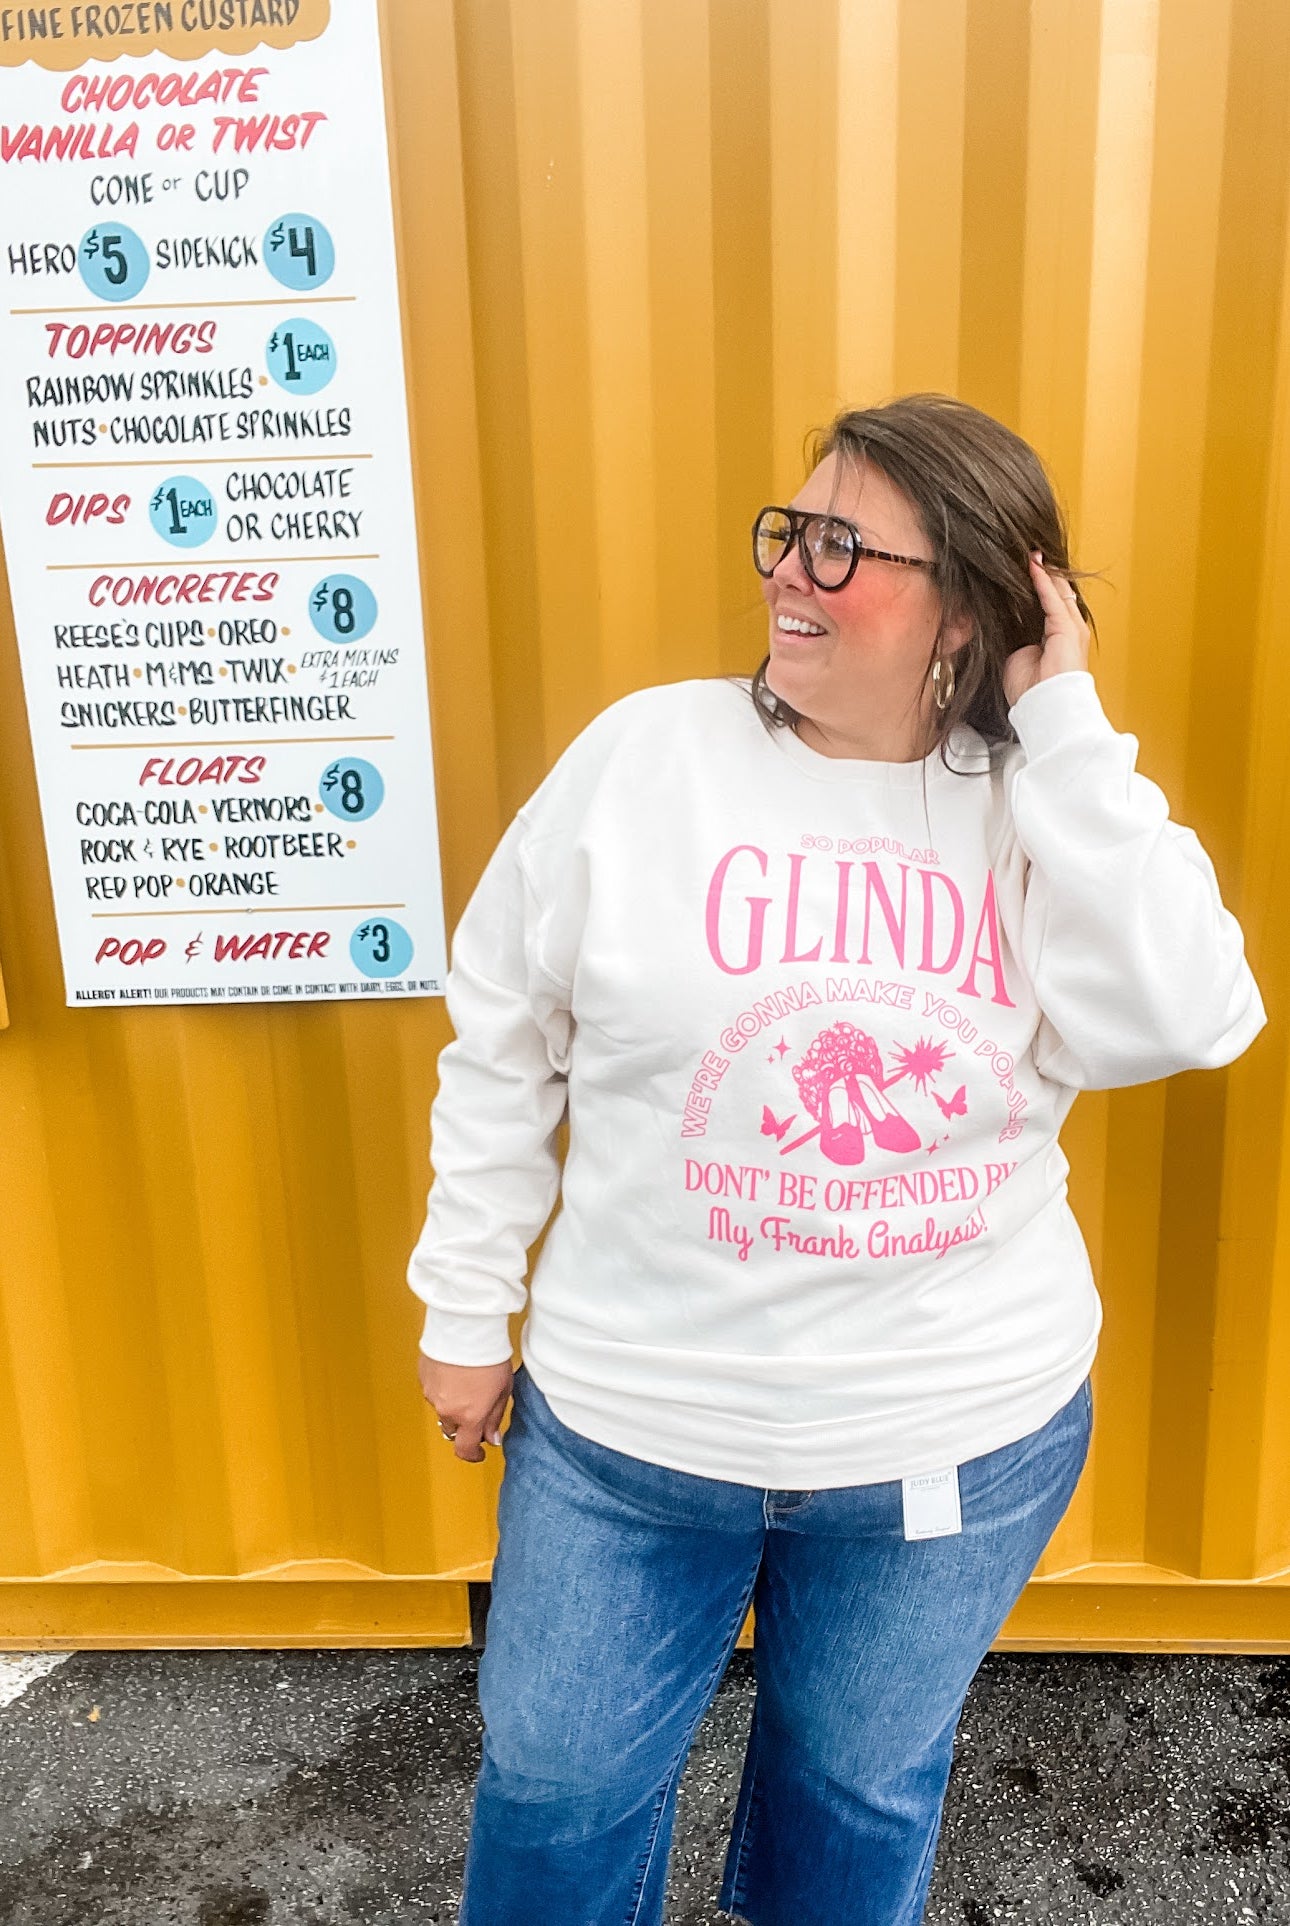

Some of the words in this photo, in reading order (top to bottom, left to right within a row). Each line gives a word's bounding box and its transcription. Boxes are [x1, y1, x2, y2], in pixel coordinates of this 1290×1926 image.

[1, 8, 65, 42] FINE
[71, 1, 173, 39] FROZEN
[180, 0, 299, 32] CUSTARD
[61, 67, 270, 114] CHOCOLATE
[0, 121, 140, 164] VANILLA
[156, 123, 196, 151] OR
[212, 111, 328, 155] TWIST
[90, 172, 155, 206] CONE
[162, 177, 182, 192] or
[194, 168, 250, 202] CUP
[7, 242, 77, 277] HERO
[83, 229, 129, 285] $5
[155, 235, 259, 269] SIDEKICK
[269, 222, 317, 277] $4
[44, 320, 218, 360] TOPPINGS
[269, 332, 301, 381] $1
[297, 343, 330, 362] EACH
[26, 372, 135, 408] RAINBOW
[141, 367, 254, 401] SPRINKLES
[33, 417, 97, 448] NUTS
[110, 414, 230, 445] CHOCOLATE
[236, 407, 352, 440] SPRINKLES
[226, 468, 354, 502] CHOCOLATE
[45, 492, 132, 527] DIPS
[150, 486, 188, 534] $1
[181, 499, 213, 519] EACH
[226, 514, 263, 543] OR
[271, 509, 364, 541] CHERRY
[88, 571, 281, 608] CONCRETES
[312, 582, 356, 635] $8
[145, 619, 205, 648] CUPS
[218, 618, 278, 646] OREO
[56, 663, 130, 689] HEATH
[225, 658, 288, 685] TWIX
[301, 650, 339, 669] EXTRA
[341, 669, 380, 688] EACH
[60, 701, 177, 728] SNICKERS
[189, 695, 356, 726] BUTTERFINGER
[139, 756, 267, 786] FLOATS
[322, 763, 365, 813] $8
[76, 800, 197, 827] COCA-COLA
[211, 796, 313, 823] VERNORS
[80, 838, 137, 865] ROCK
[162, 838, 205, 862] RYE
[800, 833, 834, 852] SO
[838, 836, 941, 865] POPULAR
[85, 876, 127, 900] RED
[134, 874, 174, 897] POP
[188, 872, 281, 896] ORANGE
[357, 923, 391, 962] $3
[705, 844, 1017, 1009] GLINDA
[94, 937, 168, 966] POP
[212, 931, 332, 964] WATER
[75, 989, 116, 1000] ALLERGY
[119, 988, 152, 999] ALERT!
[154, 988, 169, 999] OUR
[171, 987, 208, 998] PRODUCTS
[210, 987, 225, 997] MAY
[228, 986, 258, 996] CONTAIN
[273, 985, 292, 995] COME
[305, 983, 337, 994] CONTACT
[681, 1050, 730, 1138] WE'RE
[720, 982, 823, 1053] GONNA
[826, 977, 916, 1010] MAKE
[922, 992, 978, 1044] YOU
[974, 1039, 1029, 1144] POPULR
[684, 1159, 771, 1202] DONT'
[778, 1171, 817, 1210] BE
[824, 1168, 980, 1212] OFFENDED
[708, 1206, 754, 1262] My
[760, 1216, 860, 1259] Frank
[867, 1207, 989, 1260] Analysis!
